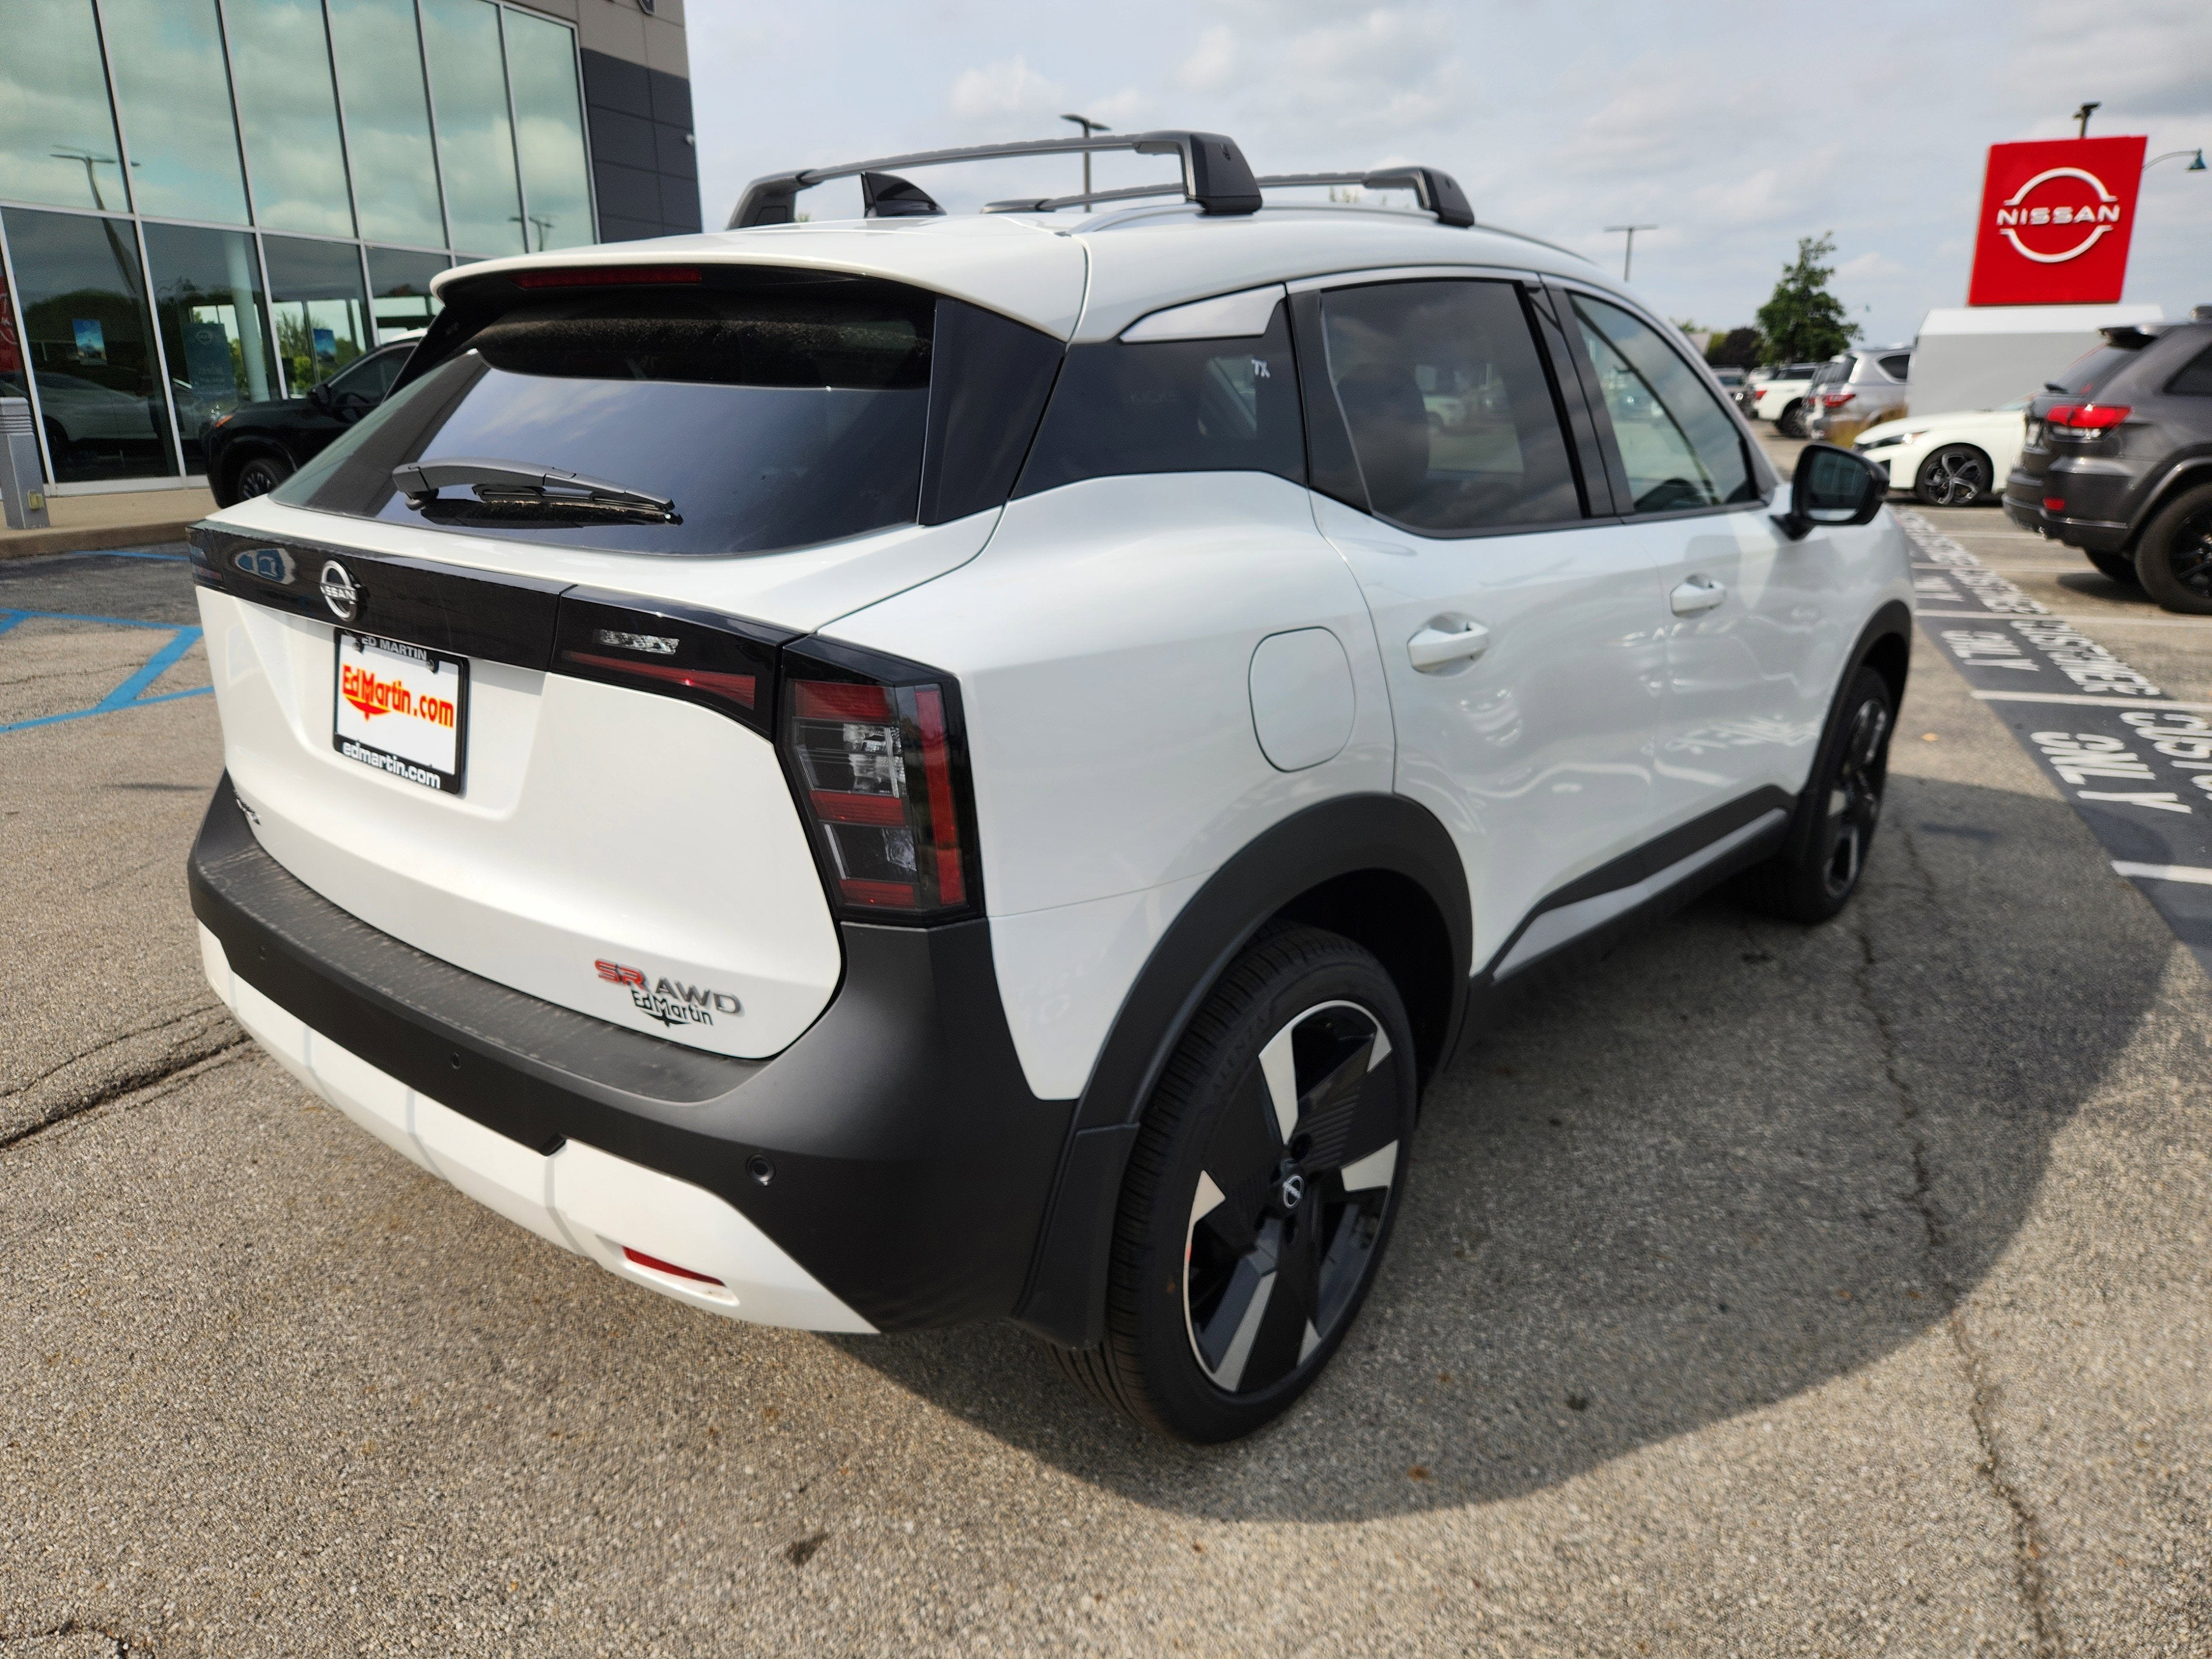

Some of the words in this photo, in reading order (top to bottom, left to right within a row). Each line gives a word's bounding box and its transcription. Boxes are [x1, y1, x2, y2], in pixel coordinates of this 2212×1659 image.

[1996, 205, 2121, 226] NISSAN
[361, 636, 377, 647] ED
[379, 639, 427, 661] MARTIN
[1941, 630, 2041, 671] ONLY
[343, 741, 441, 789] edmartin.com
[2030, 731, 2193, 814] ONLY
[594, 959, 646, 990] SR
[655, 977, 744, 1014] AWD
